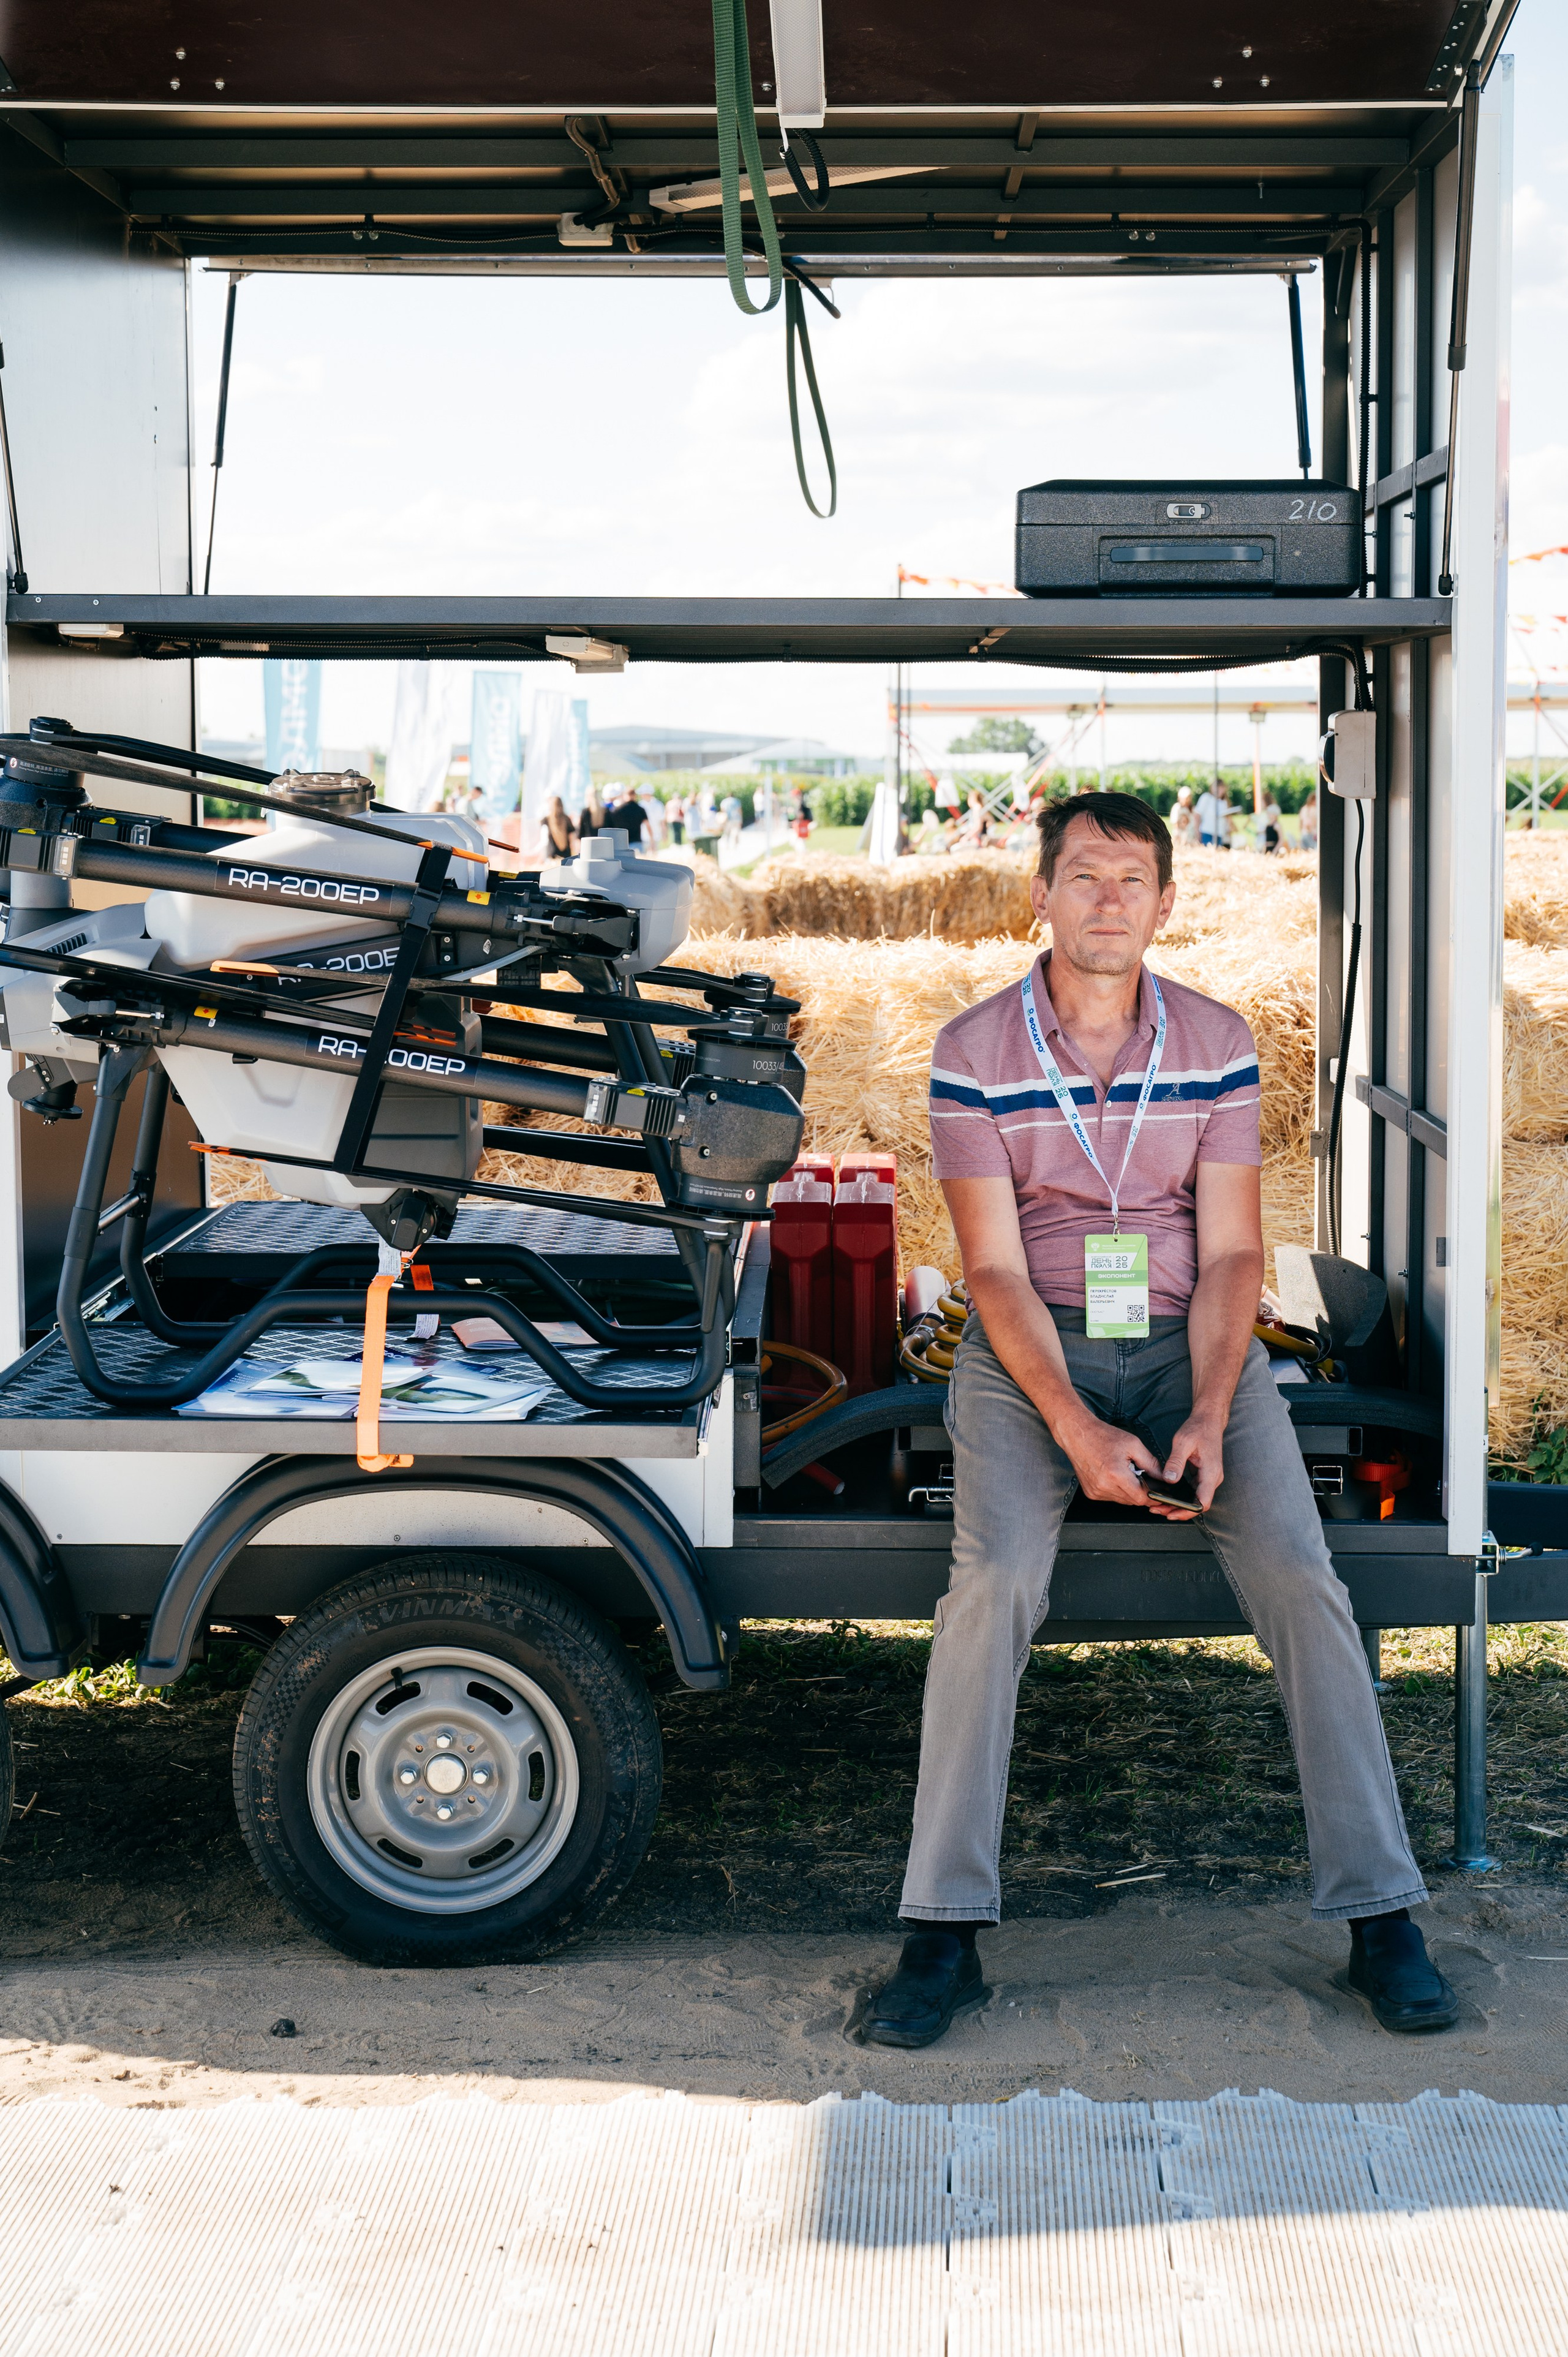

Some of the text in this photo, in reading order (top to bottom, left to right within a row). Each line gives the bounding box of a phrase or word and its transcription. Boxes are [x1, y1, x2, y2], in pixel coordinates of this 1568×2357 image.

[1288, 499, 1336, 521] 210
[228, 868, 379, 904] RA-200EP
[1029, 1017, 1044, 1052] ФОСАГРО
[318, 1036, 466, 1075] RA-00EP
[1055, 1088, 1063, 1099] 25
[1060, 1086, 1068, 1096] 20
[1143, 1065, 1156, 1101] ФОСАГРО
[1074, 1123, 1093, 1158] ФОСАГРО
[379, 1599, 525, 1631] VINMAX
